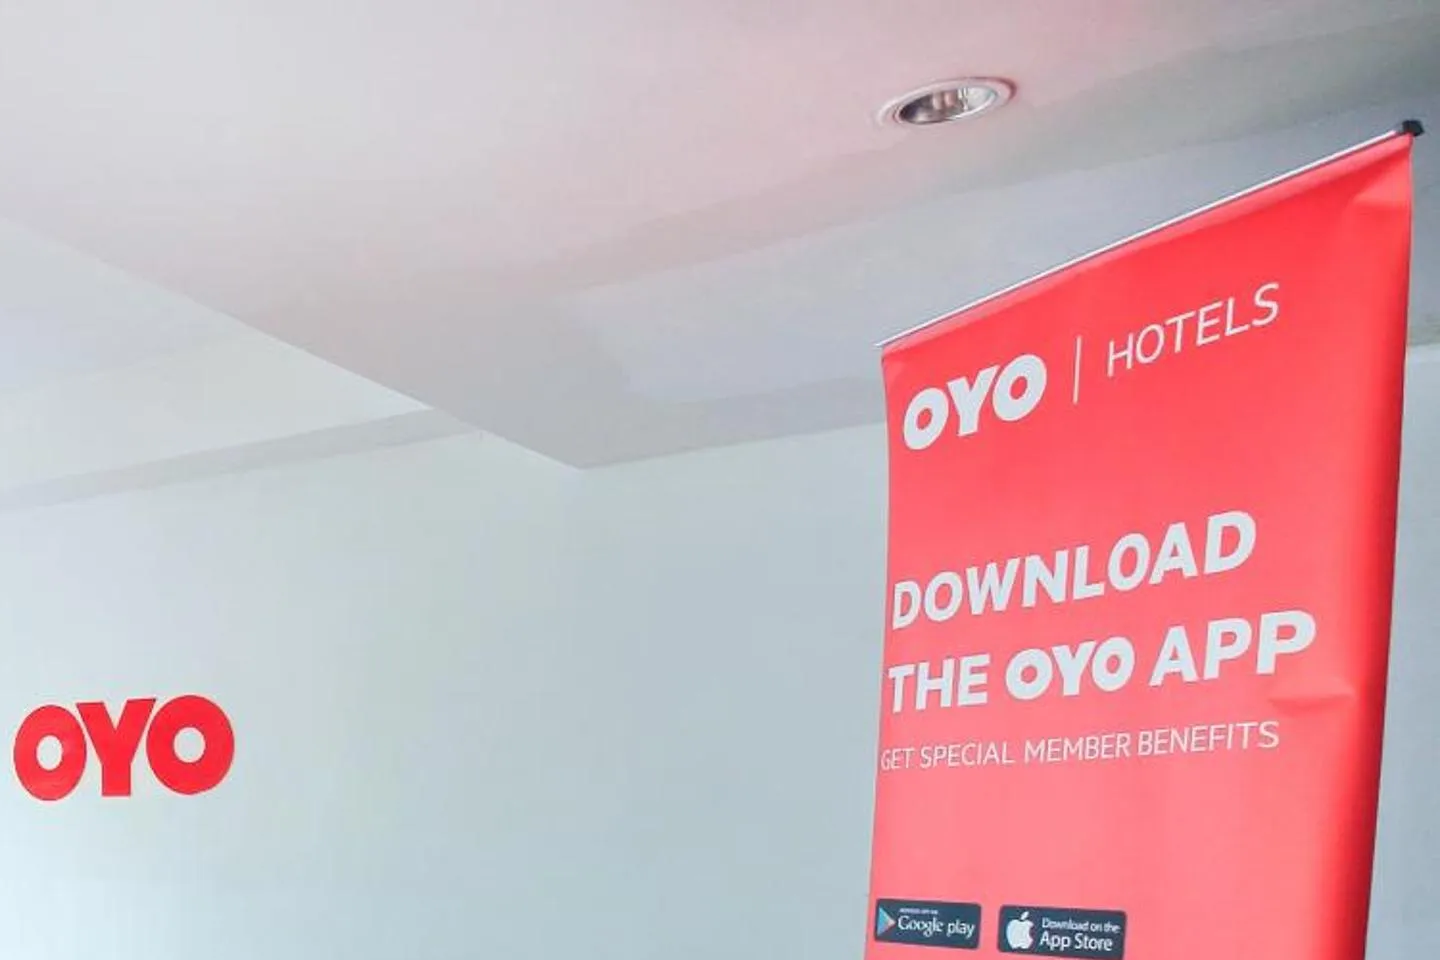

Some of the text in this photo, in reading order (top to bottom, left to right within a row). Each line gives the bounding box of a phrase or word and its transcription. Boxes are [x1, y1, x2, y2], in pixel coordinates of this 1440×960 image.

[902, 282, 1281, 450] OYO HOTELS
[891, 510, 1257, 630] DOWNLOAD
[886, 610, 1317, 714] THE OYO APP
[13, 694, 235, 801] OYO
[880, 720, 1281, 770] GET SPECIAL MEMBER BENEFITS
[897, 914, 976, 939] Google play
[1039, 930, 1113, 951] App Store
[1041, 917, 1121, 934] Download on the
